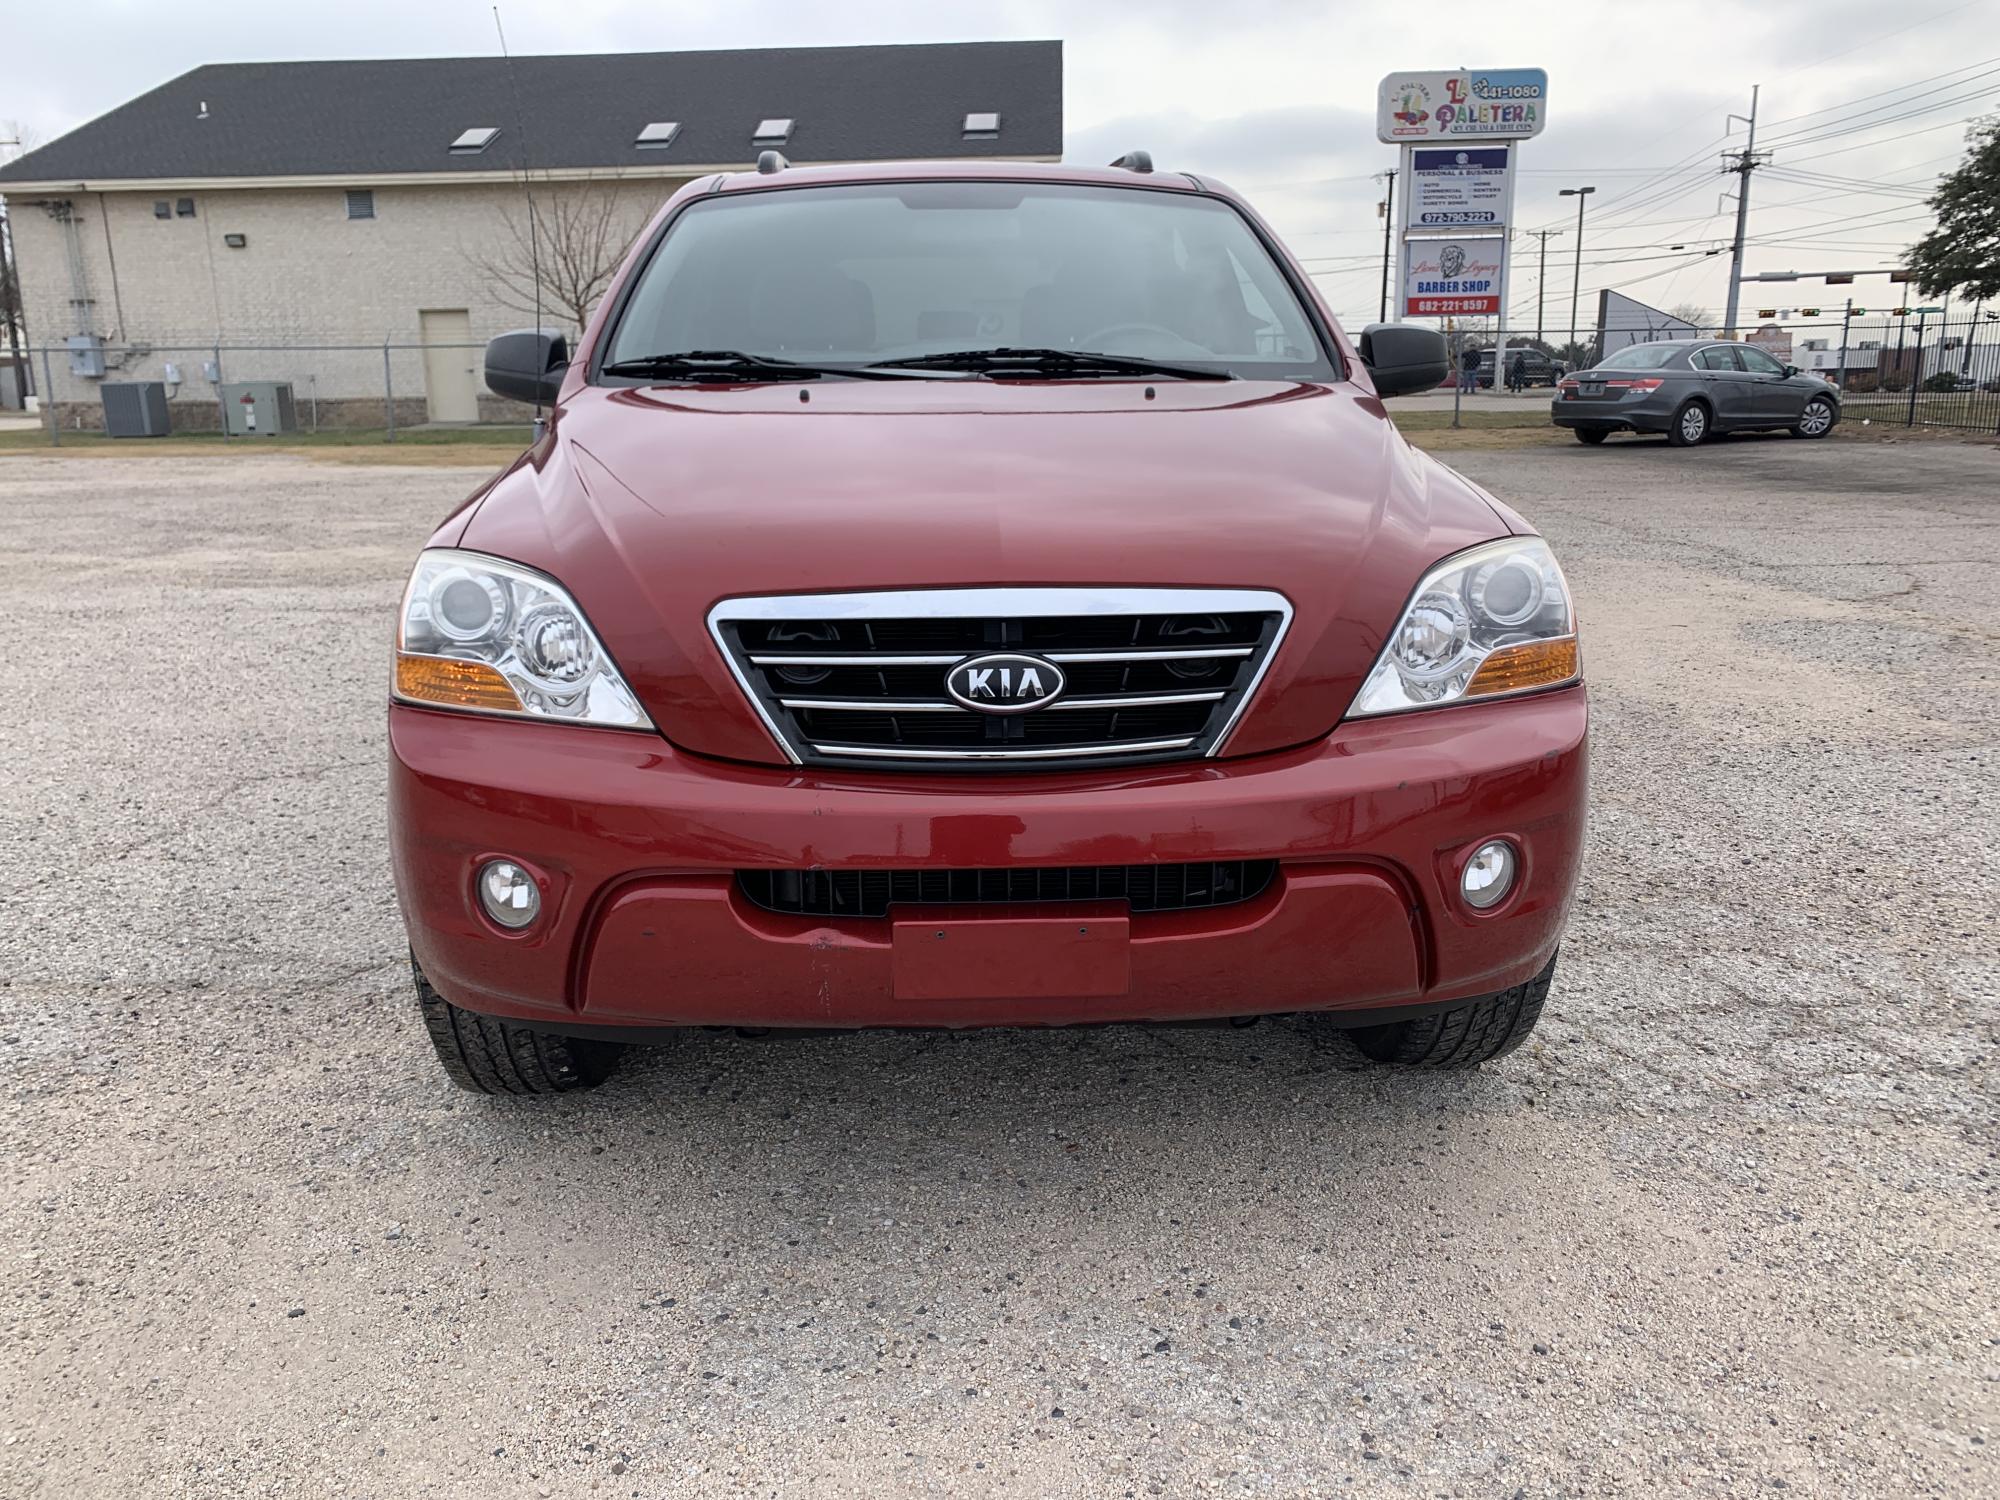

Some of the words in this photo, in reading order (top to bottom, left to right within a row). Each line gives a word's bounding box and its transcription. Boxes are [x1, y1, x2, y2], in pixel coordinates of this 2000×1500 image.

[1446, 79, 1469, 104] LA
[1480, 86, 1540, 98] 441-1080
[1435, 102, 1536, 132] PALETERA
[1424, 212, 1491, 223] 972-790-2221
[1417, 281, 1459, 293] BARBER
[1462, 280, 1491, 292] SHOP
[967, 668, 1045, 698] KIA
